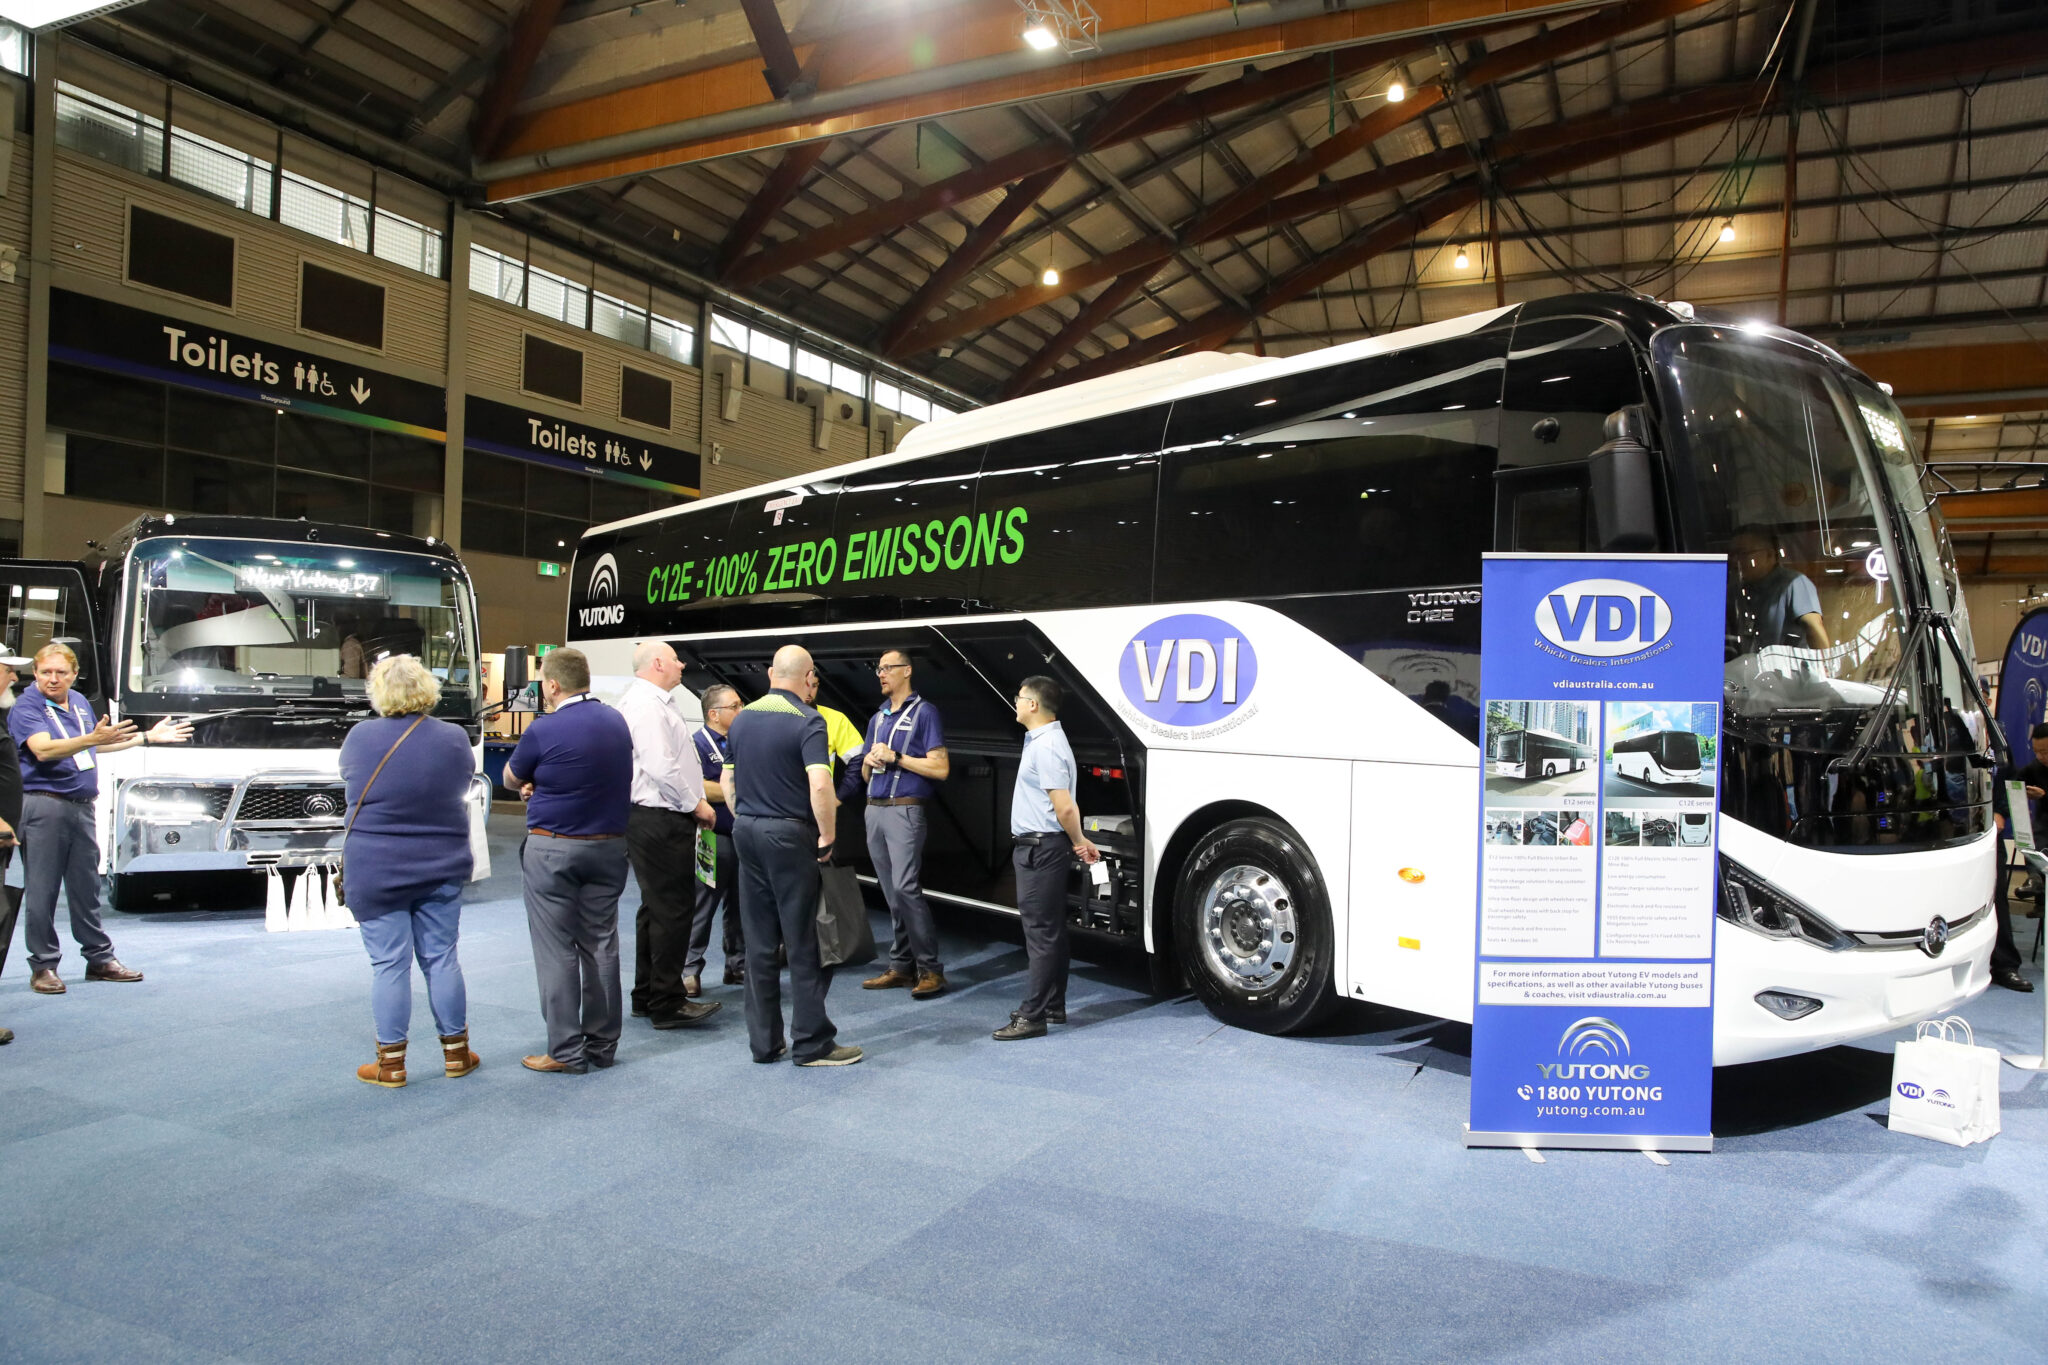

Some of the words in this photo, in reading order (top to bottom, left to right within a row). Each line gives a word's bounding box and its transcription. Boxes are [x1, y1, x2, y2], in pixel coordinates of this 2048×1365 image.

[163, 326, 280, 385] Toilets
[528, 418, 597, 459] Toilets
[647, 560, 694, 604] C12E
[763, 537, 837, 591] ZERO
[842, 506, 1028, 582] EMISSONS
[290, 569, 350, 594] Yutong
[353, 573, 380, 592] D7
[1408, 590, 1482, 607] YUTONG
[579, 604, 625, 627] YUTONG
[1407, 608, 1454, 623] C12E
[1548, 594, 1656, 643] VDI
[1533, 638, 1568, 661] Vehicle
[1569, 655, 1608, 668] Dealers
[1610, 640, 1675, 667] International
[2020, 632, 2048, 661] VDI
[1132, 638, 1240, 705] VDI
[1552, 679, 1654, 689] vdiaustralia.com.au
[1150, 724, 1189, 741] Dealers
[1191, 703, 1259, 741] International
[1563, 798, 1576, 806] E12
[1577, 798, 1595, 806] series
[1678, 799, 1695, 807] C12E
[1696, 799, 1714, 807] series
[1493, 970, 1507, 978] For
[1531, 970, 1580, 979] information
[1582, 970, 1606, 979] about
[1608, 971, 1637, 982] Yutong
[1639, 971, 1650, 979] EV
[1651, 971, 1681, 980] models
[1683, 971, 1698, 980] and
[1487, 980, 1544, 990] specifications,
[1557, 980, 1574, 989] well
[1575, 982, 1584, 990] as
[1586, 980, 1608, 990] other
[1610, 980, 1647, 990] available
[1648, 981, 1678, 992] Yutong
[1680, 981, 1703, 990] buses
[1523, 990, 1530, 999] &
[1531, 990, 1566, 1000] coaches,
[1568, 990, 1585, 999] visit
[1587, 990, 1667, 1000] vdiaustralia.com.au
[1536, 1063, 1650, 1080] YUTONG
[1537, 1086, 1581, 1101] 1800
[1585, 1086, 1663, 1101] YUTONG
[1900, 1083, 1922, 1098] VDI
[1536, 1105, 1645, 1118] yutong.com.au
[1926, 1098, 1956, 1109] YUTONG
